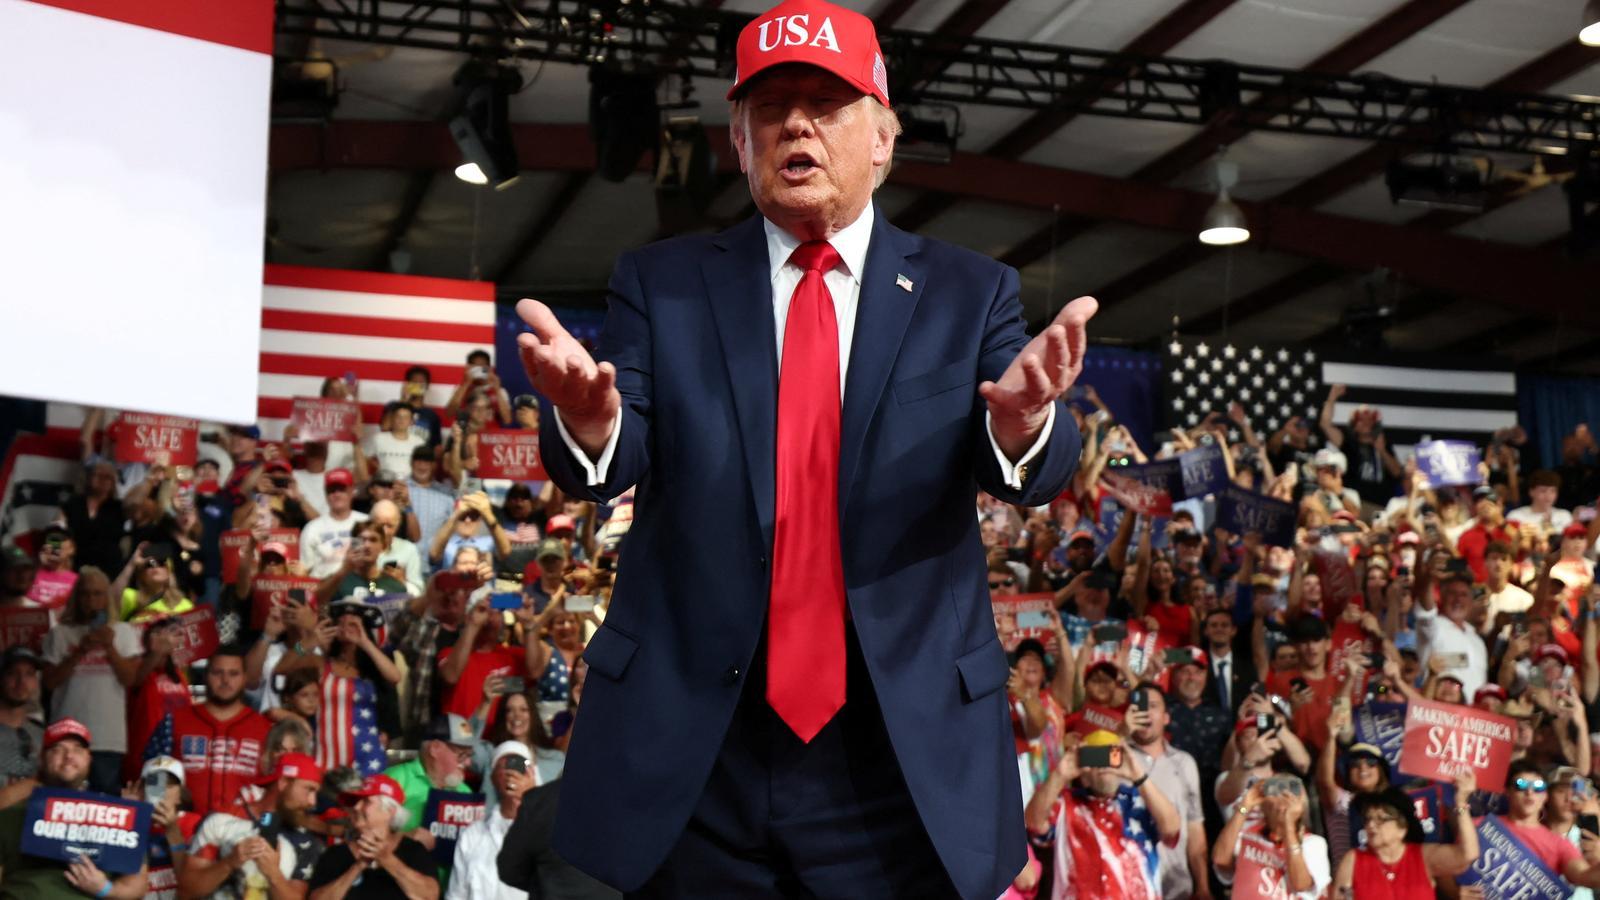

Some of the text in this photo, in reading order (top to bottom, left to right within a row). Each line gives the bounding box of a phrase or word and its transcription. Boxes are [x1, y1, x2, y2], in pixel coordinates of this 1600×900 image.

[758, 14, 842, 53] USA
[304, 409, 343, 430] SAFE
[134, 424, 183, 451] SAFE
[492, 444, 538, 467] SAFE
[1233, 501, 1281, 534] SAFE
[1411, 705, 1512, 742] MAKING AMERICA
[1425, 726, 1492, 769] SAFE
[50, 801, 131, 826] PROTECT
[33, 819, 139, 849] OUR BORDERS
[430, 821, 458, 840] OUR
[1480, 820, 1524, 863] MAKING
[1257, 866, 1296, 900] SA
